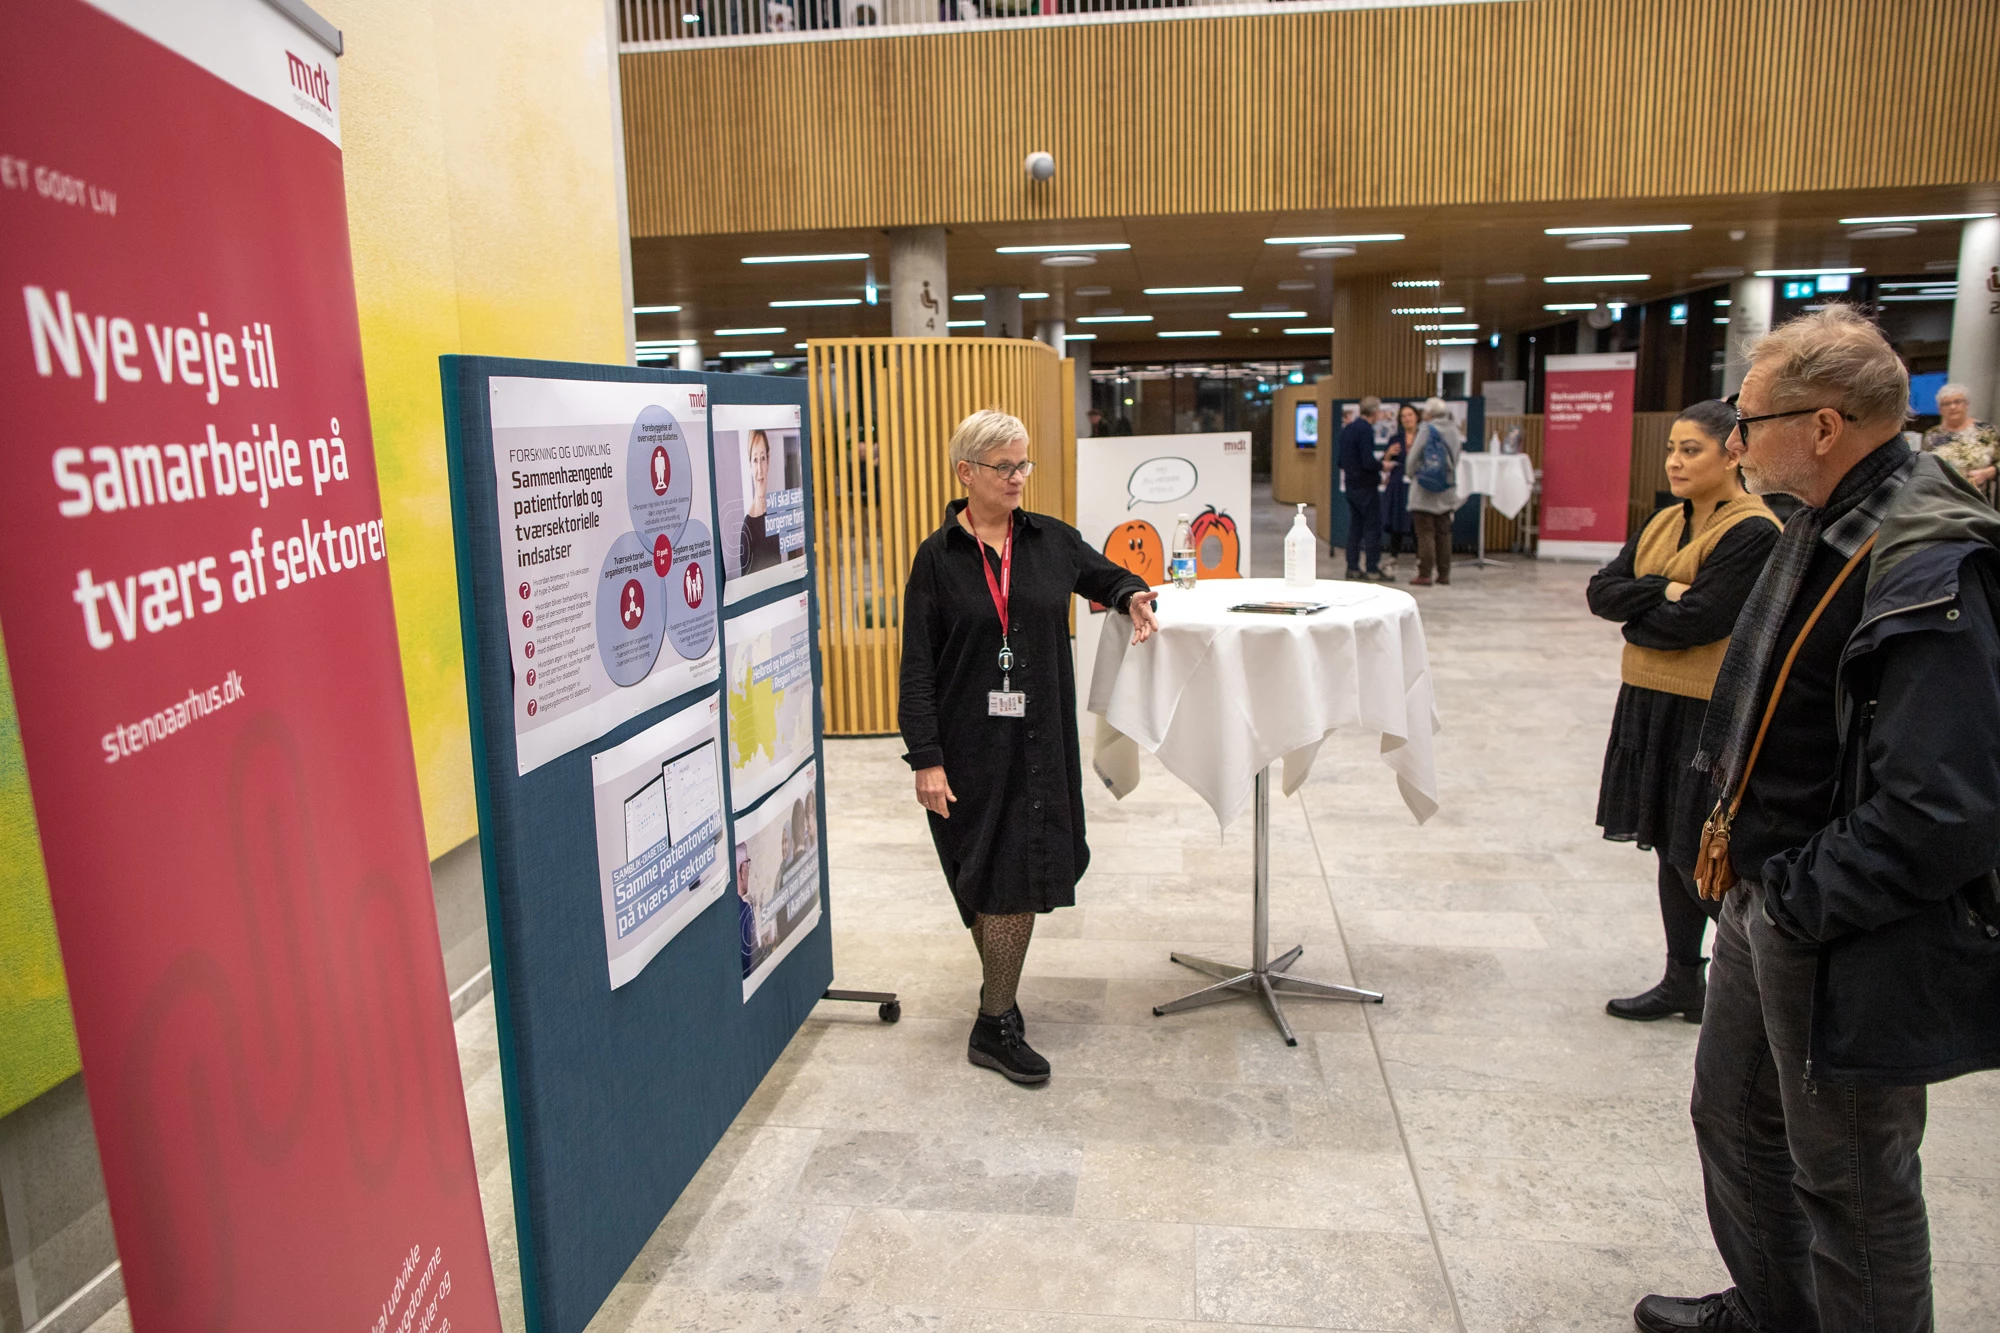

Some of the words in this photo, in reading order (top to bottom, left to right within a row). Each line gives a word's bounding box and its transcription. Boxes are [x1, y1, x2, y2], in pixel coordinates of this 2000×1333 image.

[34, 165, 86, 206] GODT
[89, 185, 117, 217] LIV
[23, 285, 142, 403] Nye
[144, 311, 239, 405] veje
[242, 322, 279, 388] til
[925, 316, 935, 331] 4
[52, 423, 303, 517] samarbejde
[308, 417, 349, 496] på
[509, 446, 557, 463] FORSKNING
[558, 445, 571, 458] OG
[572, 443, 611, 458] UDVIKLING
[511, 463, 613, 489] Sammenhængende
[513, 491, 588, 520] patientforløb
[591, 489, 603, 509] og
[515, 512, 600, 542] tværsektorielle
[765, 514, 793, 533] borgerne
[517, 543, 572, 568] indsatser
[605, 564, 633, 579] organisering
[633, 563, 639, 572] og
[639, 559, 653, 569] ledelse
[613, 551, 645, 565] Tværsektoriel
[72, 568, 223, 649] tværs
[229, 527, 267, 603] af
[271, 518, 386, 590] sektorer
[101, 669, 245, 763] stenoaarhus.dk
[613, 839, 667, 883] SAMBLIK-DIABETES:
[615, 863, 659, 905] Samme
[660, 813, 722, 880] patientoverblik
[618, 905, 636, 937] på
[636, 889, 668, 920] tværs
[669, 876, 679, 896] af
[680, 843, 716, 886] sektorer
[388, 1244, 421, 1315] udvikle
[396, 1246, 442, 1333] gdomme
[418, 1293, 438, 1333] ikler
[439, 1270, 451, 1300] og
